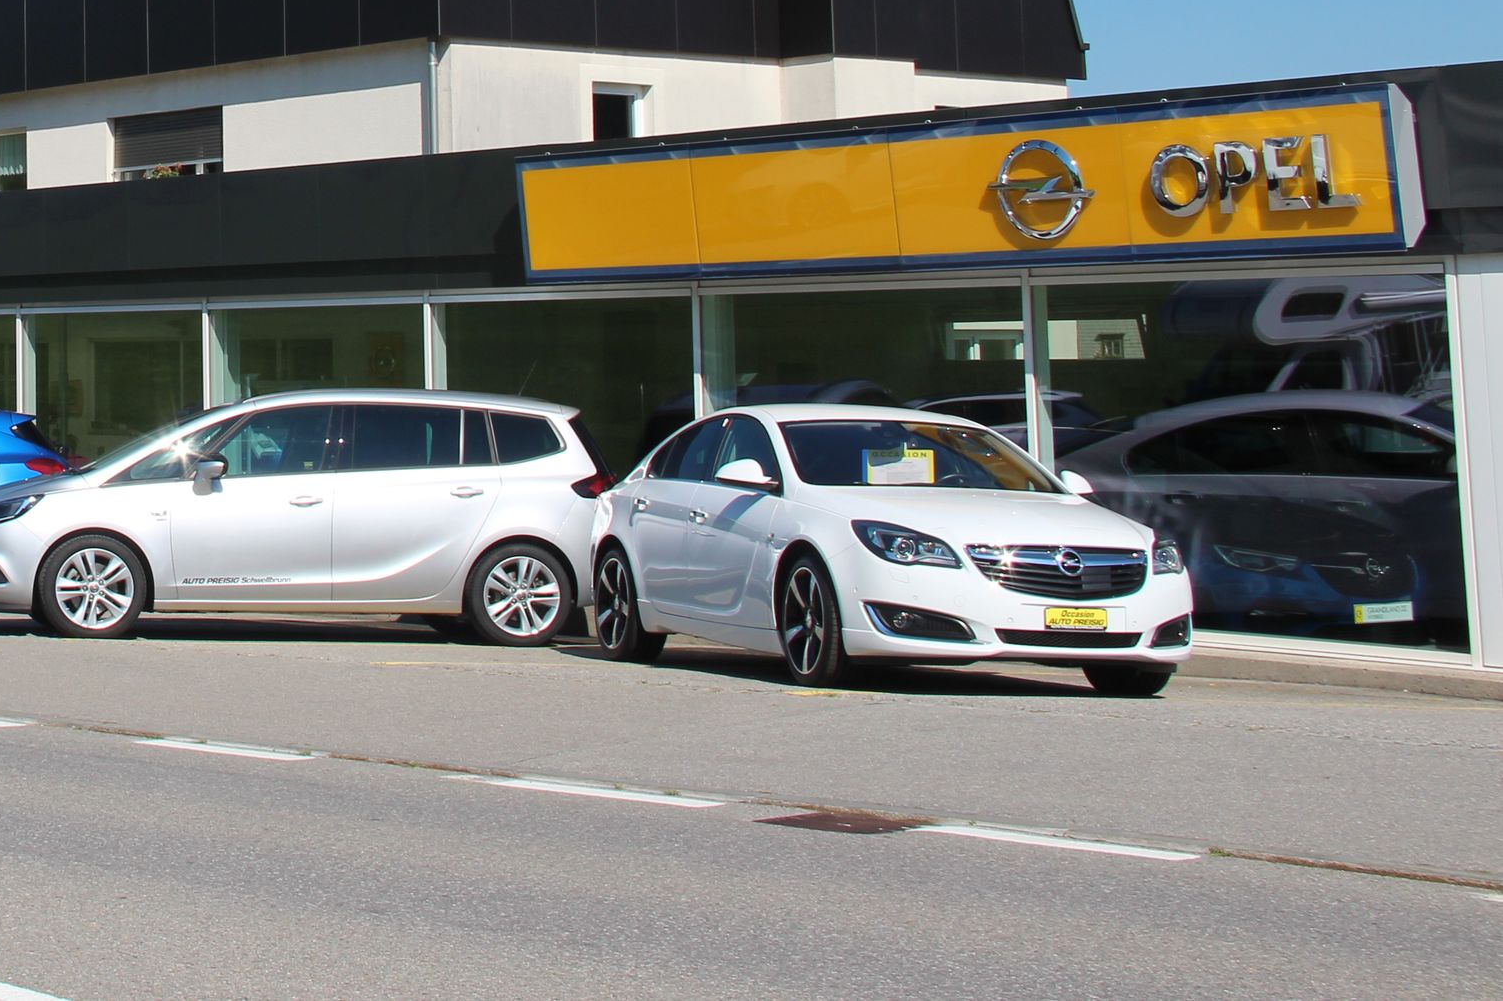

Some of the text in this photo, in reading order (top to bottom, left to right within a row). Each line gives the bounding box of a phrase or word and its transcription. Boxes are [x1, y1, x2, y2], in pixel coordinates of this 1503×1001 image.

[1151, 134, 1362, 217] OPEL
[182, 577, 205, 585] AUTO
[206, 576, 239, 584] PREISIG
[1073, 618, 1104, 626] PREISIG
